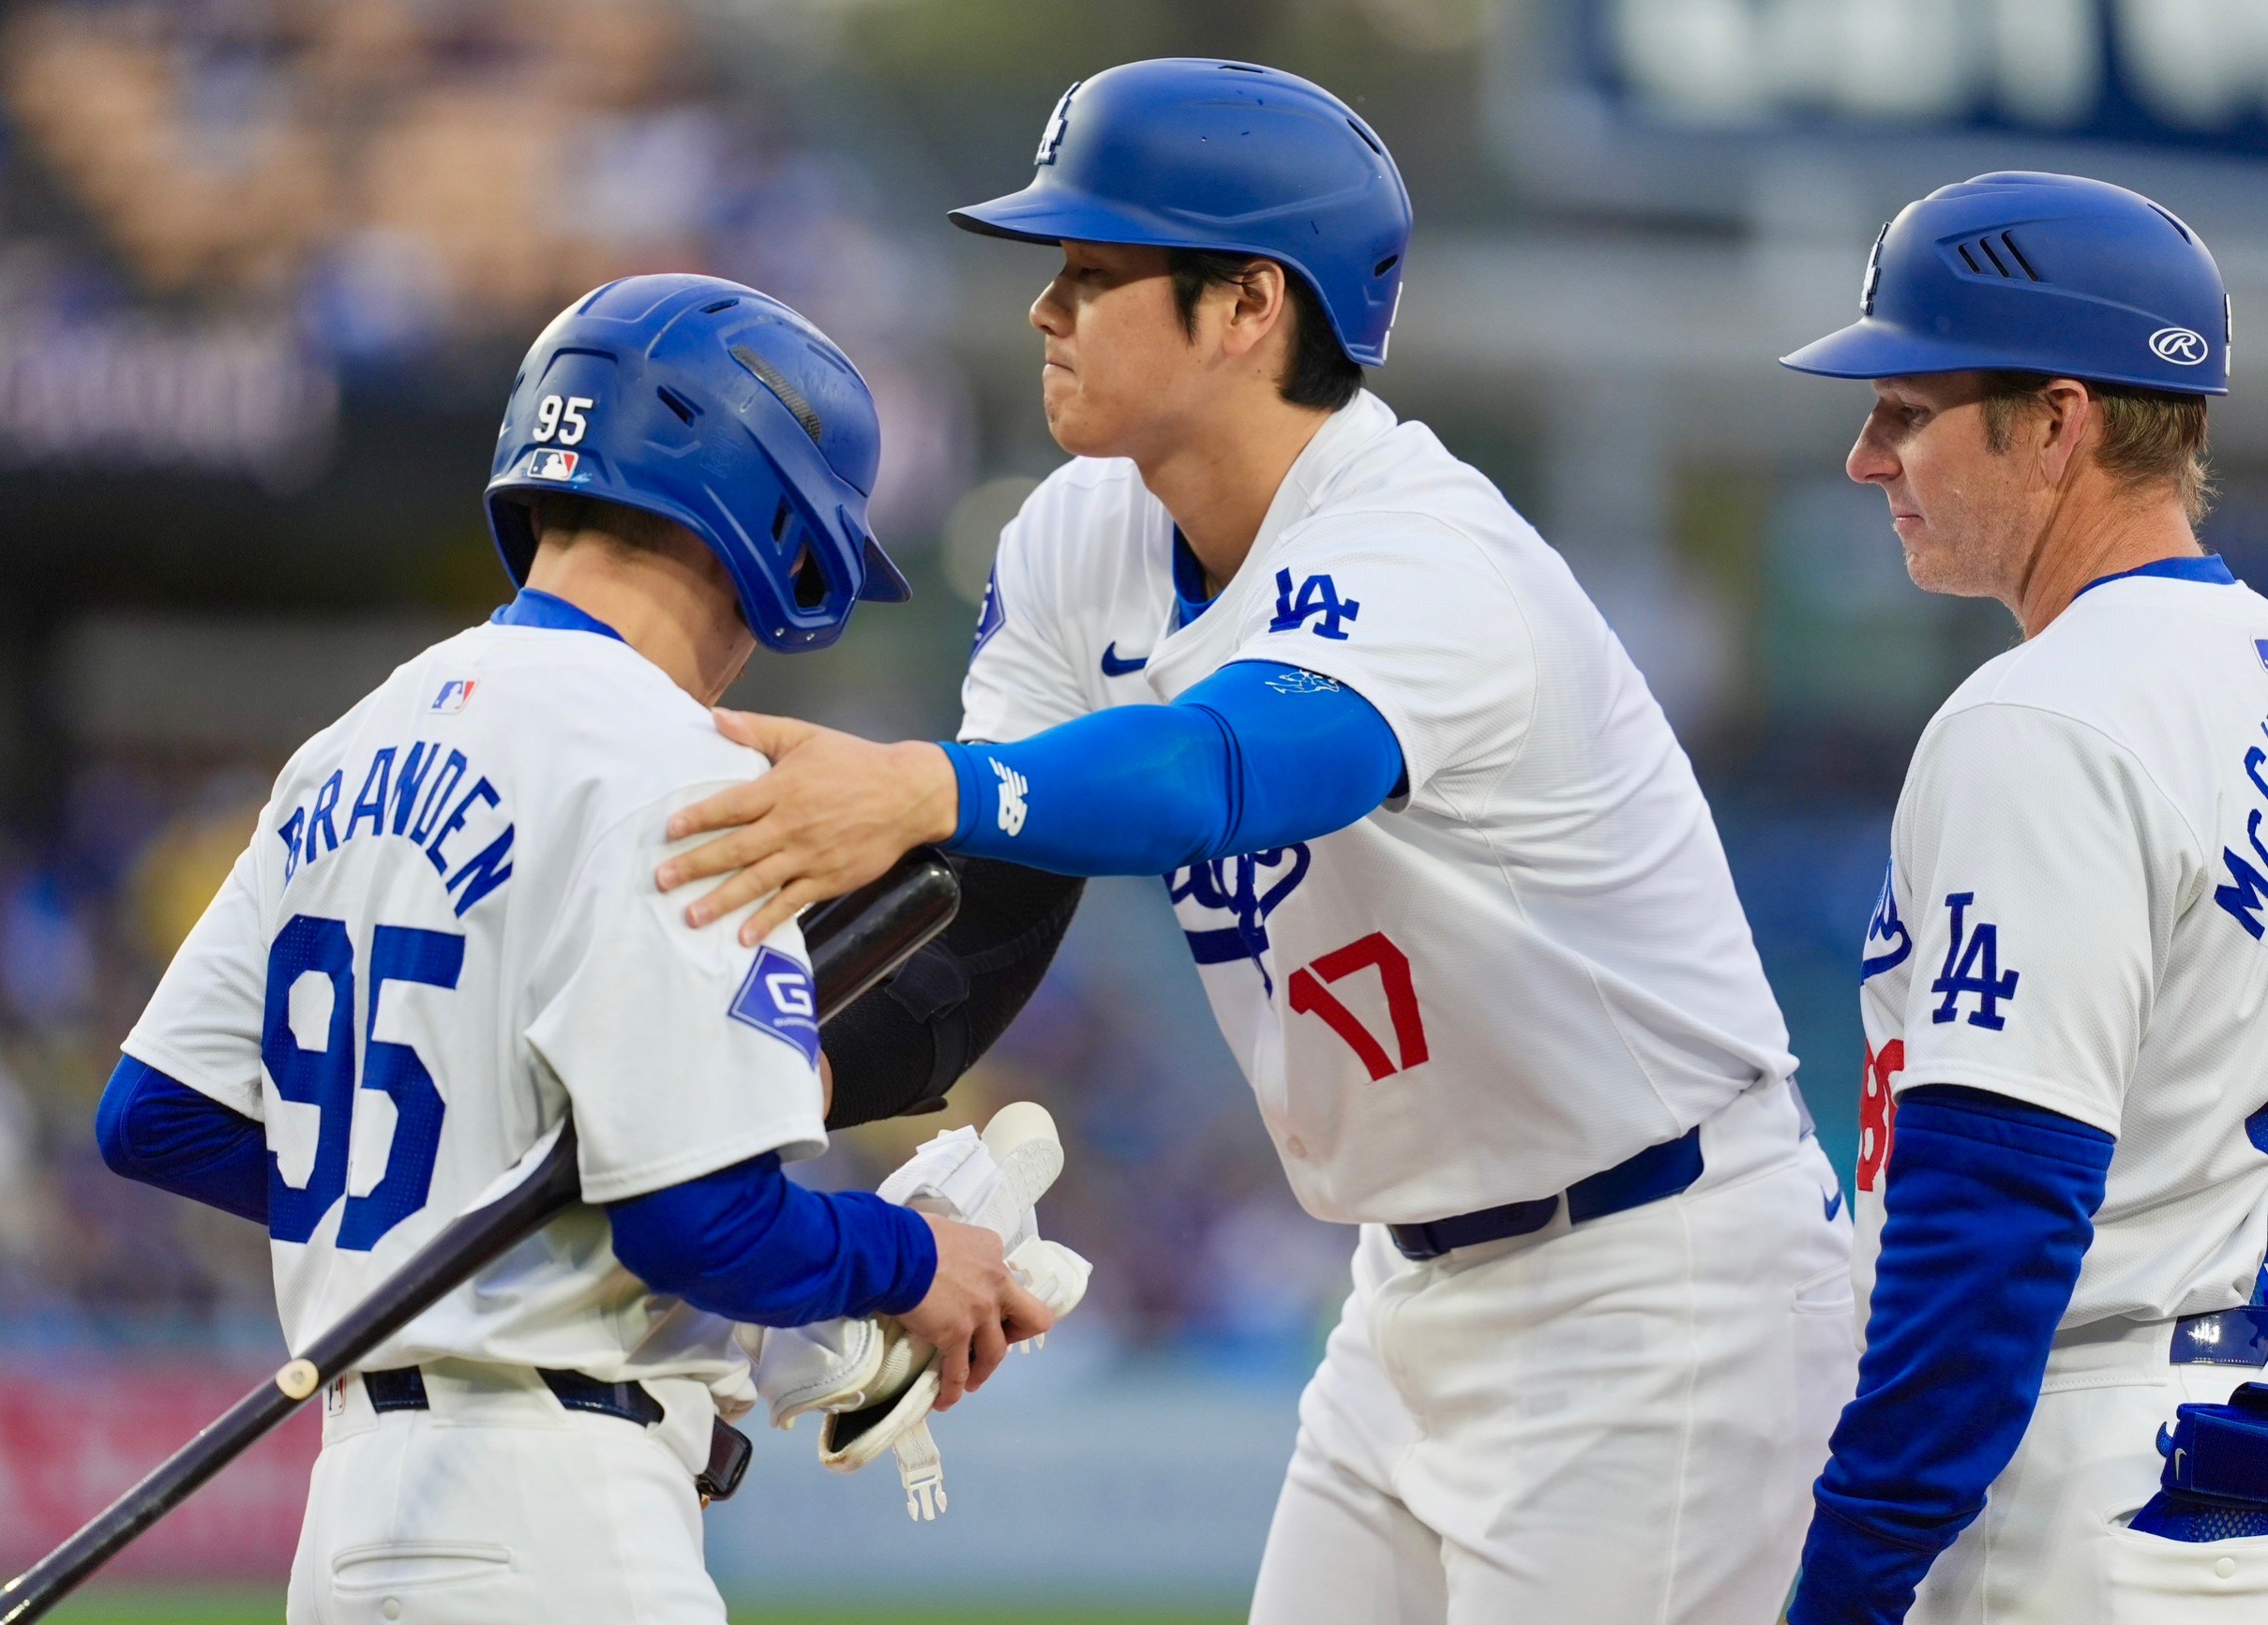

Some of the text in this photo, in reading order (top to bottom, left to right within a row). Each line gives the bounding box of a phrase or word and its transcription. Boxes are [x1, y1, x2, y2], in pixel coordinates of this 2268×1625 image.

[533, 395, 593, 445] 95
[1269, 566, 1360, 640] LA
[278, 740, 516, 918] BRANDEN
[765, 972, 814, 1017] G
[1288, 931, 1430, 1082] 17
[1931, 891, 2020, 1031] LA
[261, 913, 466, 1253] 95
